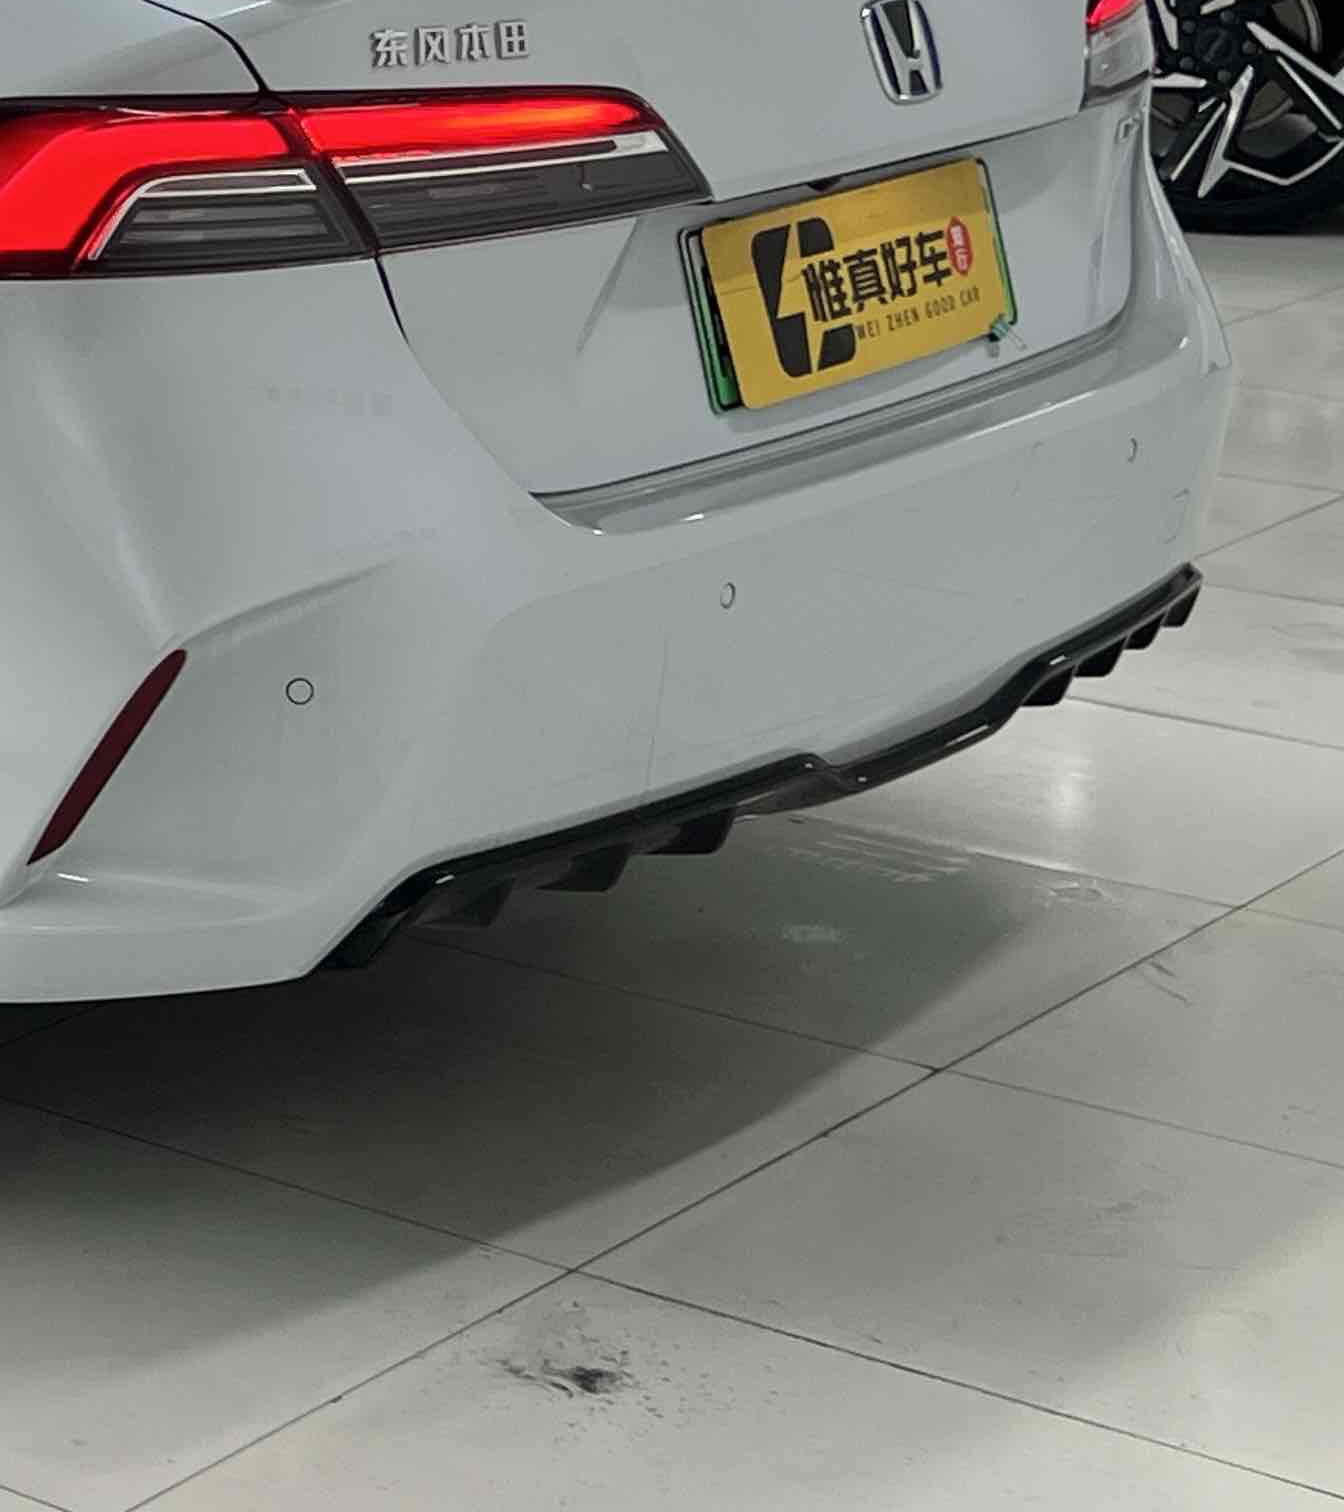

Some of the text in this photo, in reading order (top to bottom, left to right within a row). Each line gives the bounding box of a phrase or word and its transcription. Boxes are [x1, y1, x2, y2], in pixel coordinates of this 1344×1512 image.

[368, 18, 529, 68] 东风本田
[856, 284, 981, 340] WEI ZHEN GOOD CAR
